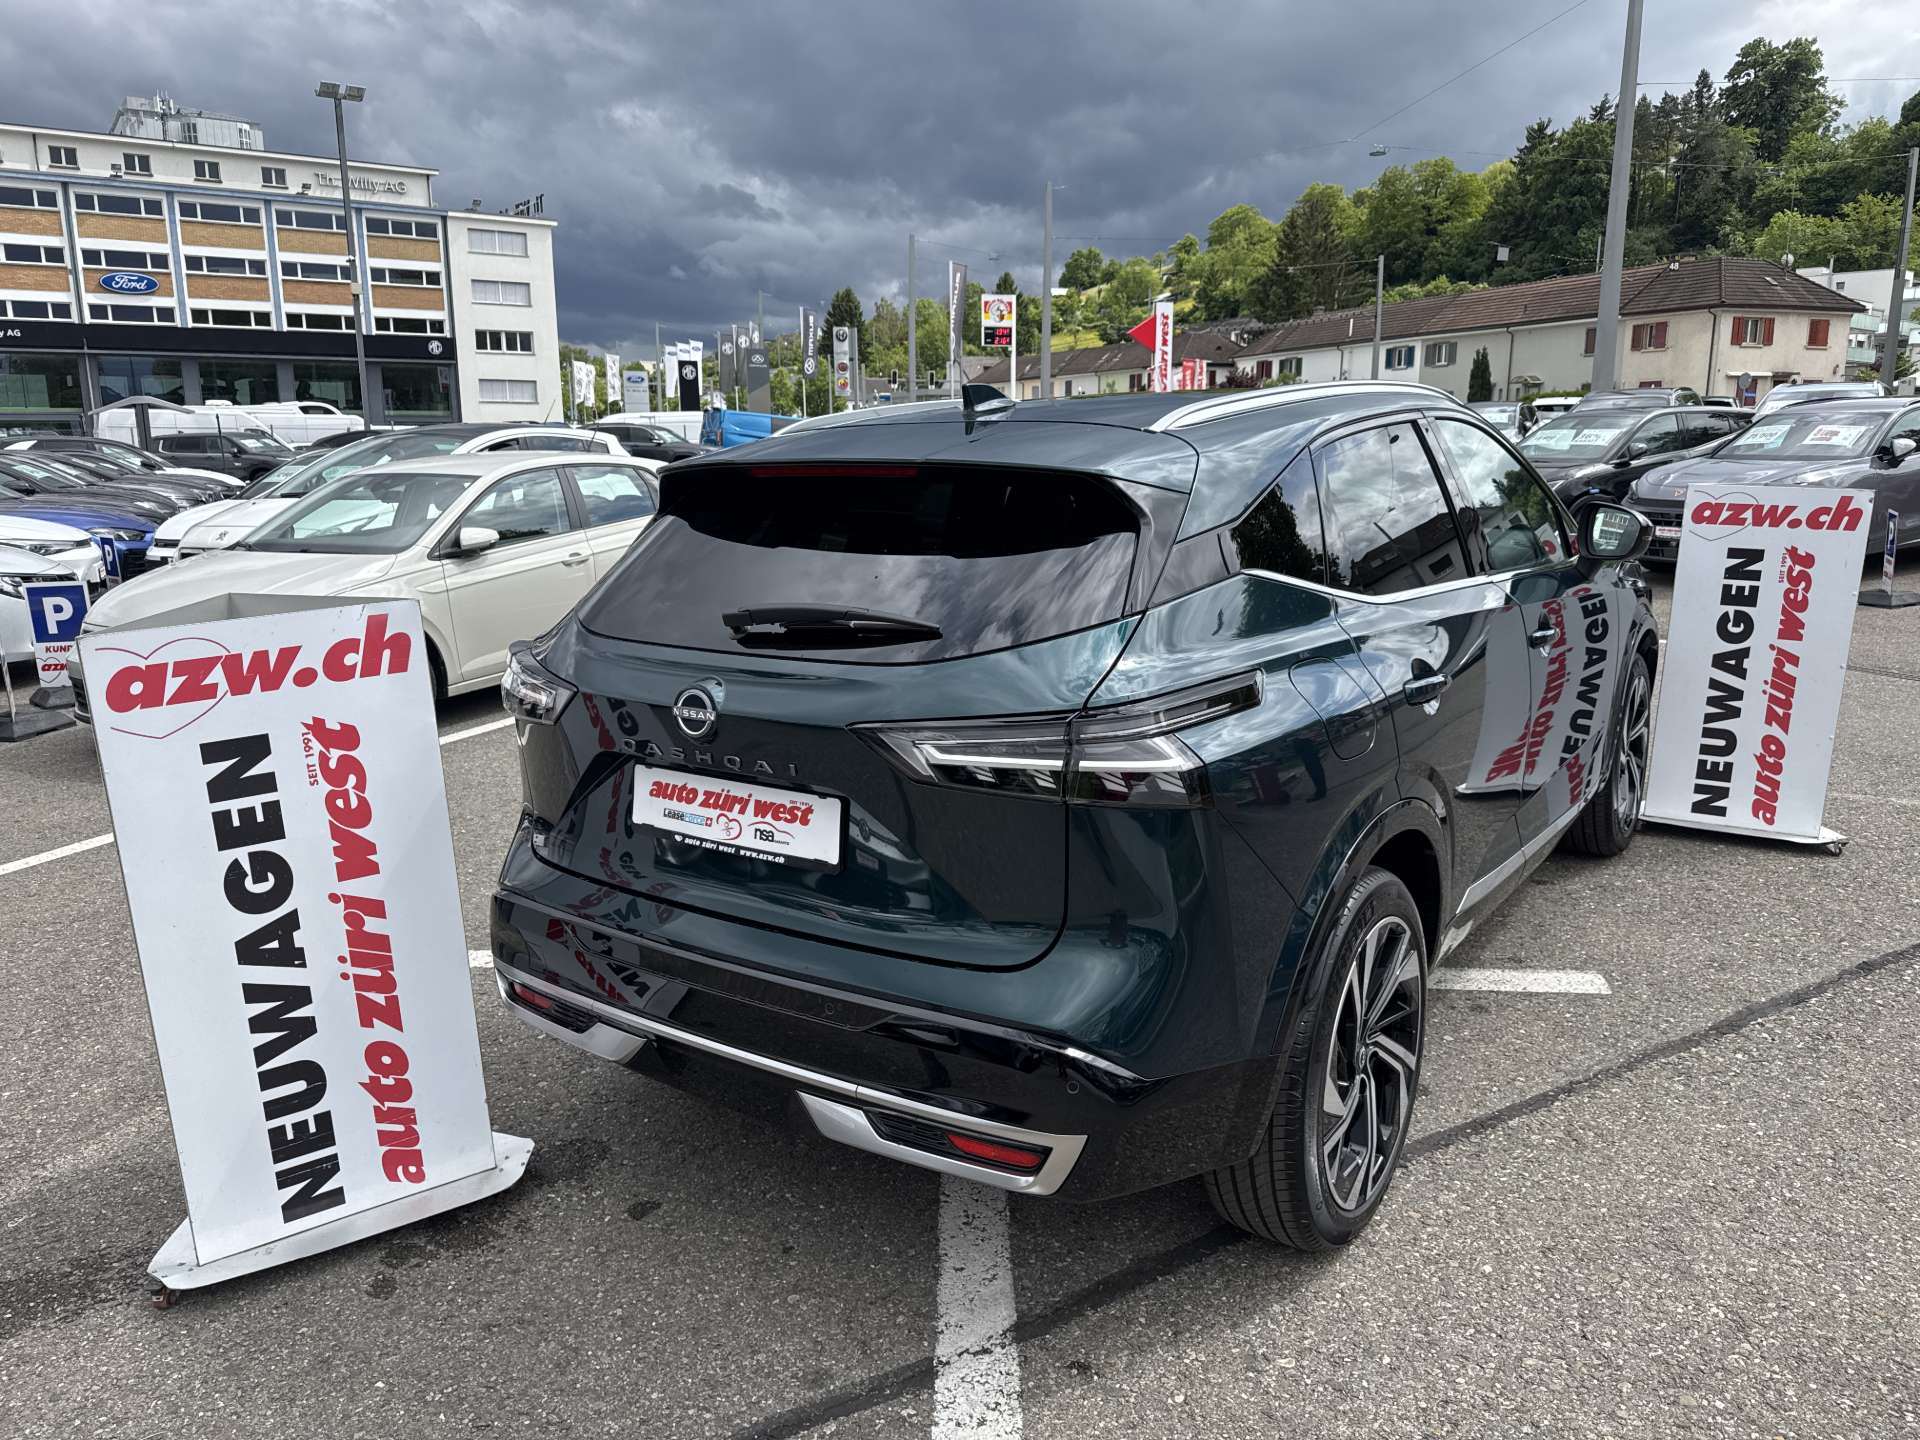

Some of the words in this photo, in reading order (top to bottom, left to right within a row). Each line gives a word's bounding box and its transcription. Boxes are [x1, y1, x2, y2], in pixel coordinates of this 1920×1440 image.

[384, 179, 407, 194] AG
[112, 275, 147, 289] Ford
[6, 328, 21, 337] AG
[1690, 495, 1864, 531] azw.ch
[1777, 545, 1816, 641] west
[42, 596, 74, 634] P
[105, 613, 412, 713] azw.ch
[1691, 547, 1765, 817] NEUWAGEN
[1762, 643, 1800, 736] züri
[673, 705, 716, 721] NISSAN
[301, 731, 314, 758] 1991
[622, 738, 798, 777] QASHQAI
[306, 763, 319, 786] SEIT
[1752, 734, 1787, 826] auto
[300, 716, 381, 882] west
[649, 780, 698, 804] auto
[698, 788, 753, 816] züri
[753, 799, 814, 827] west
[684, 837, 701, 847] auto
[718, 843, 736, 854] west
[754, 827, 774, 842] nsa
[199, 733, 346, 1224] NEUWAGEN
[327, 892, 405, 1033] züri
[357, 1040, 426, 1184] auto
